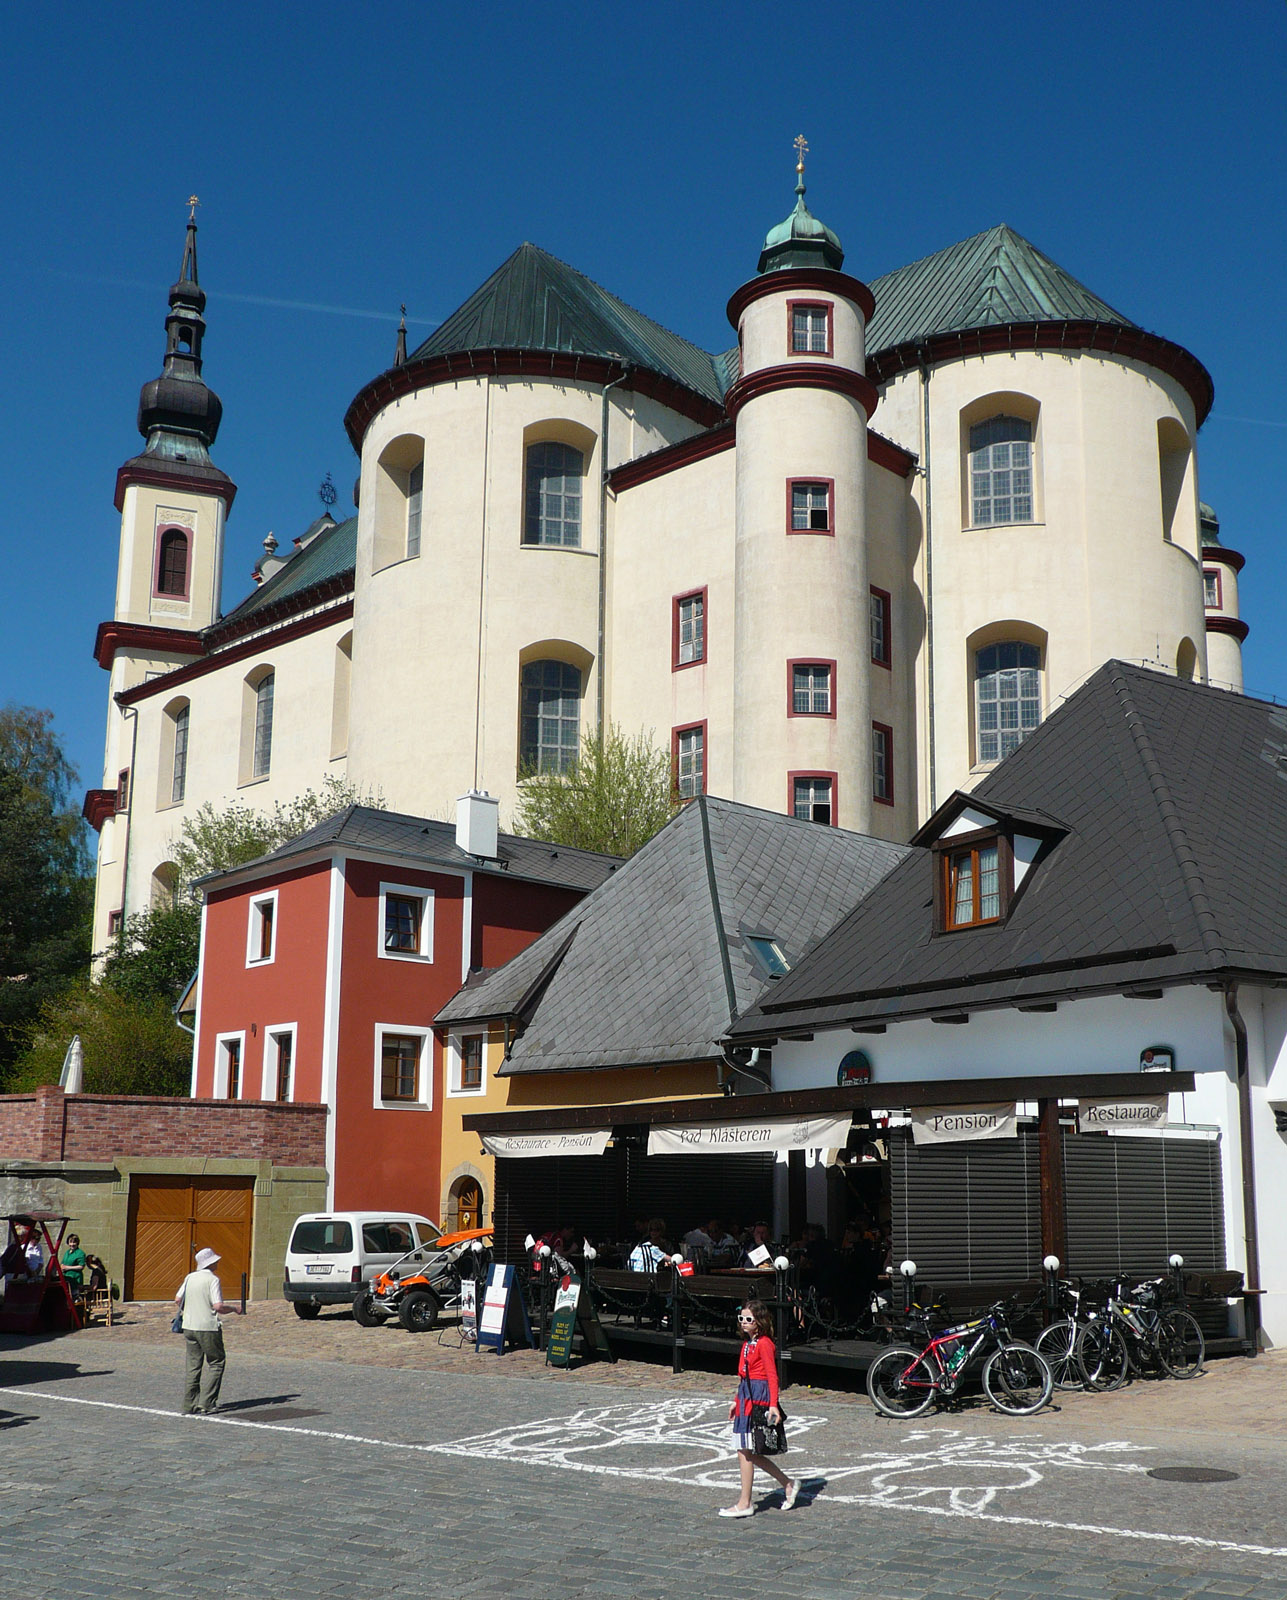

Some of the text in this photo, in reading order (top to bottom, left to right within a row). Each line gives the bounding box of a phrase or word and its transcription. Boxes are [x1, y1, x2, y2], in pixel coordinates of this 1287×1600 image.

[1087, 1105, 1163, 1121] Restaurace
[933, 1112, 997, 1131] Pension
[505, 1138, 551, 1150] Restaurace
[557, 1134, 593, 1148] Pension
[680, 1127, 772, 1144] Pod Klášterem
